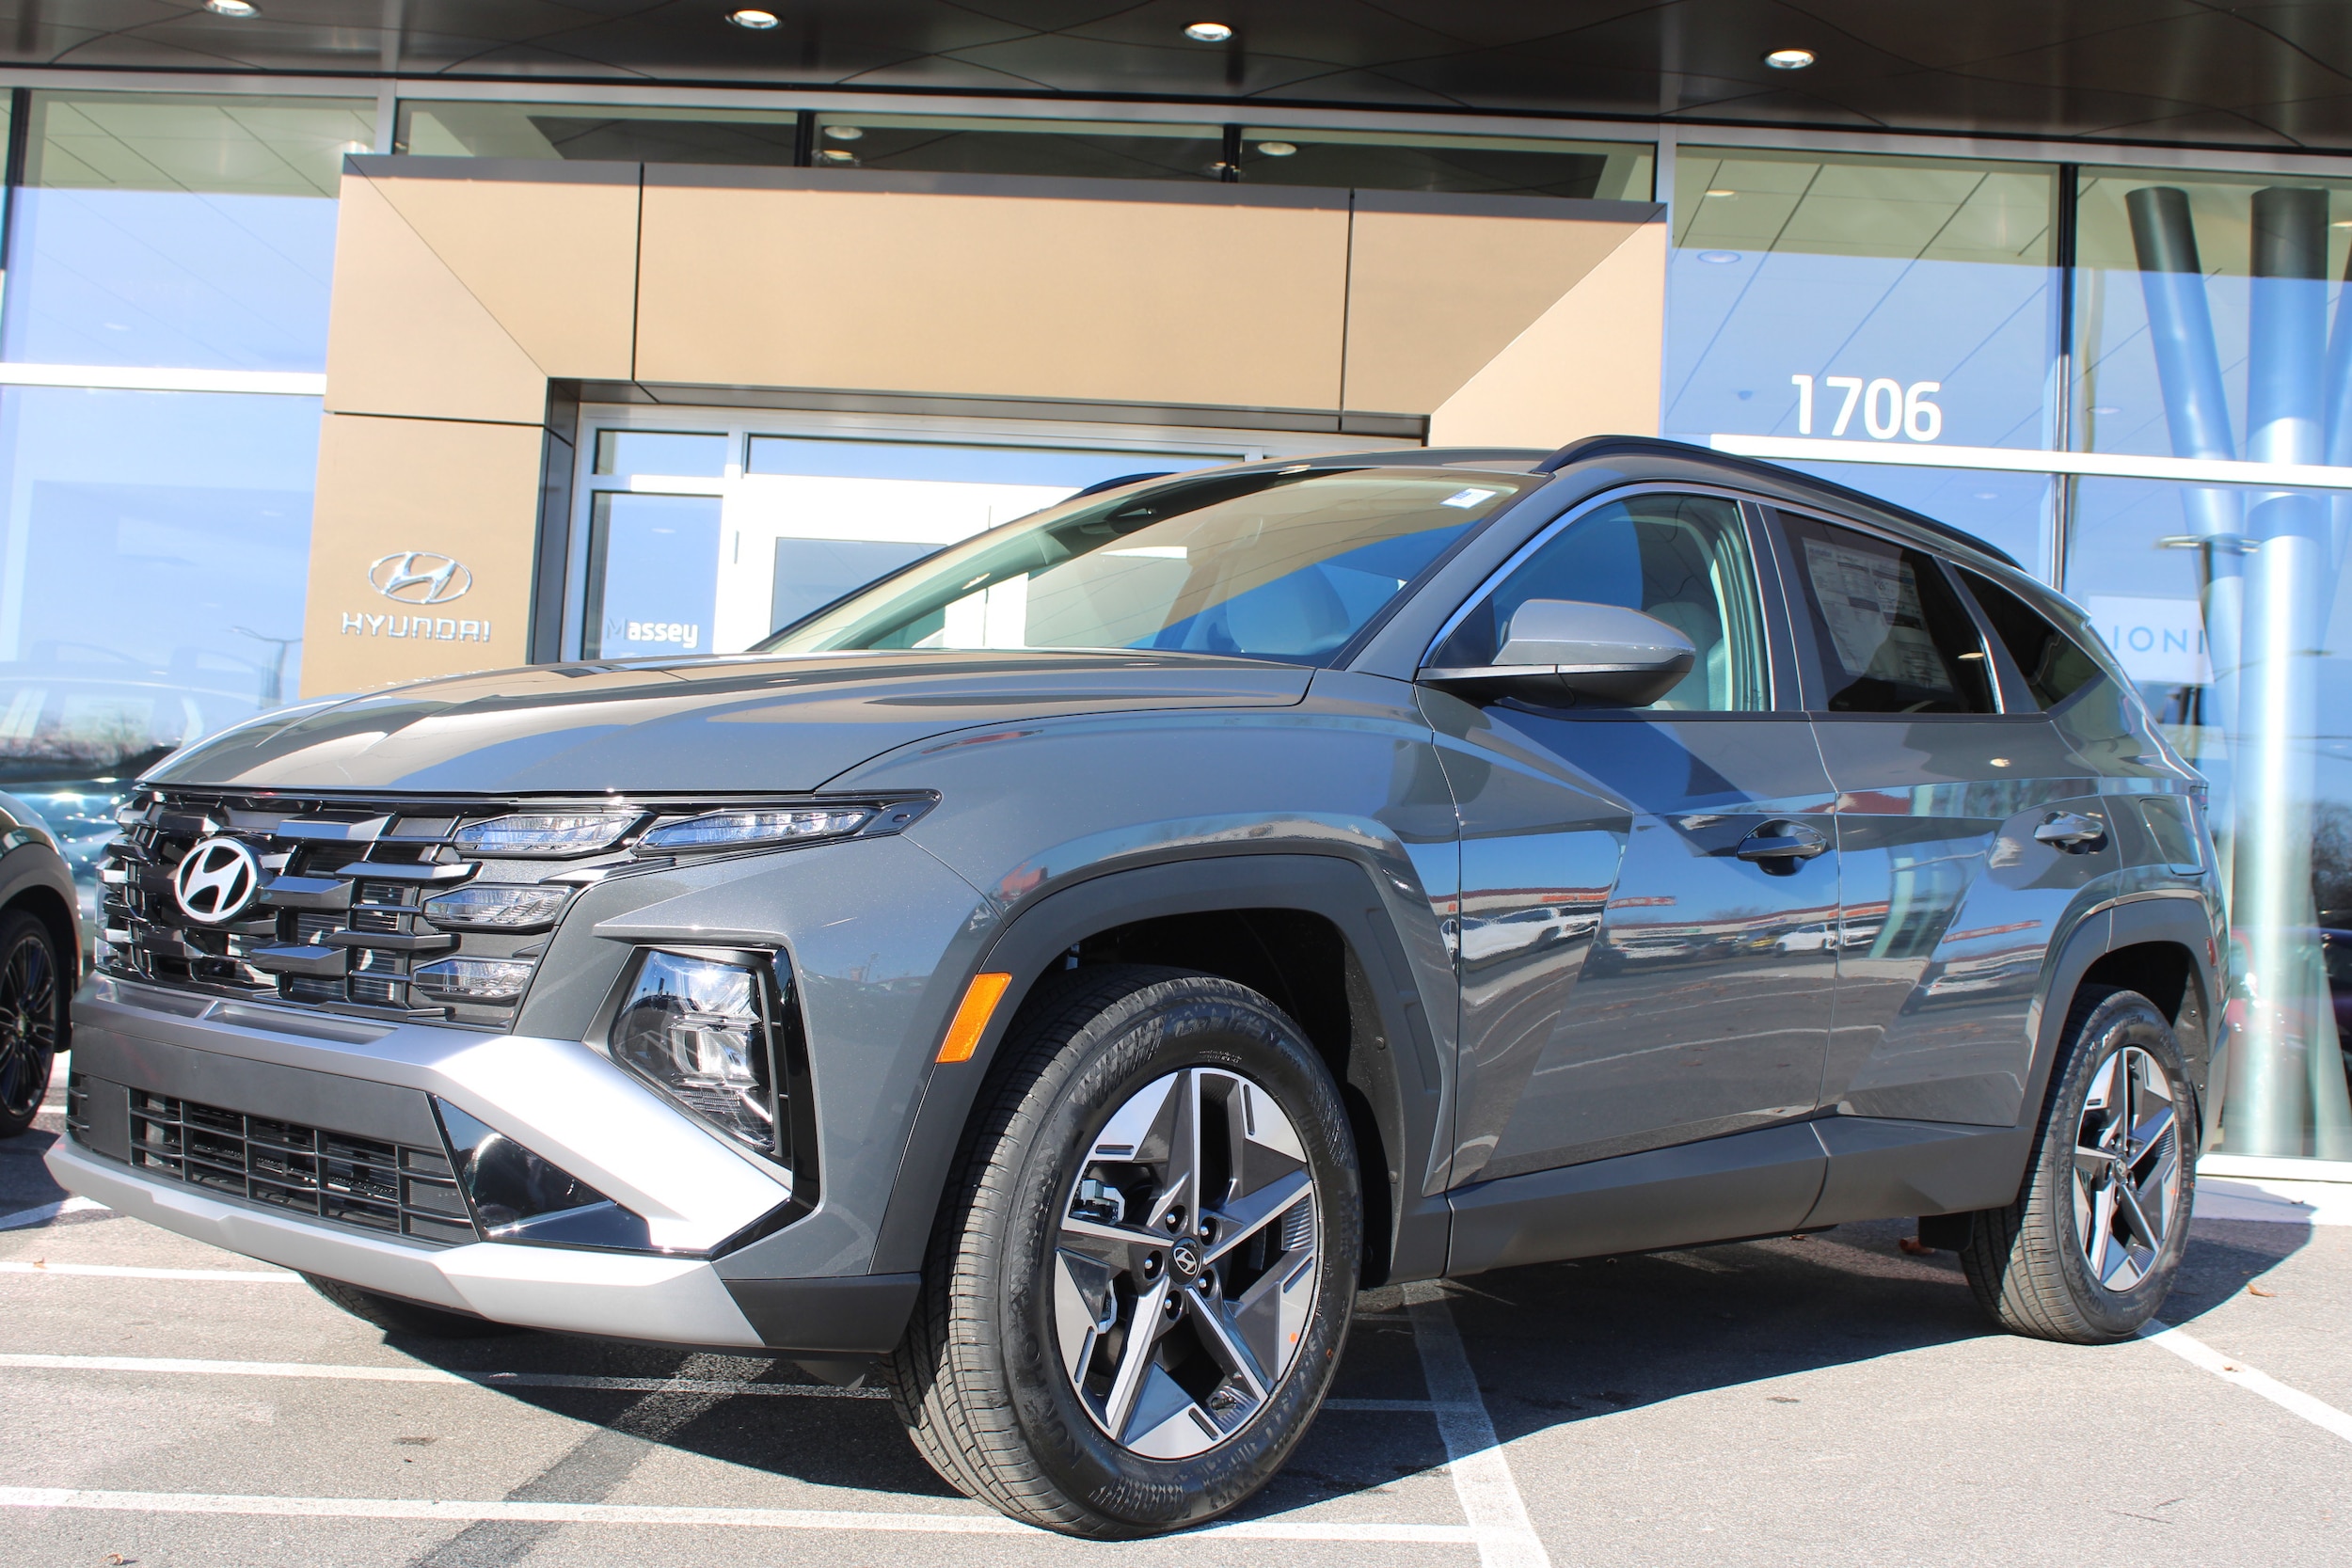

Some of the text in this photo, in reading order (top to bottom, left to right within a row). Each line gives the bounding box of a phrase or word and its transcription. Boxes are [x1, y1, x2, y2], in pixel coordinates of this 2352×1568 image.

[1791, 374, 1942, 442] 1706
[342, 611, 491, 642] HYUNDAI
[606, 618, 698, 649] Massey
[2113, 626, 2203, 655] IONI
